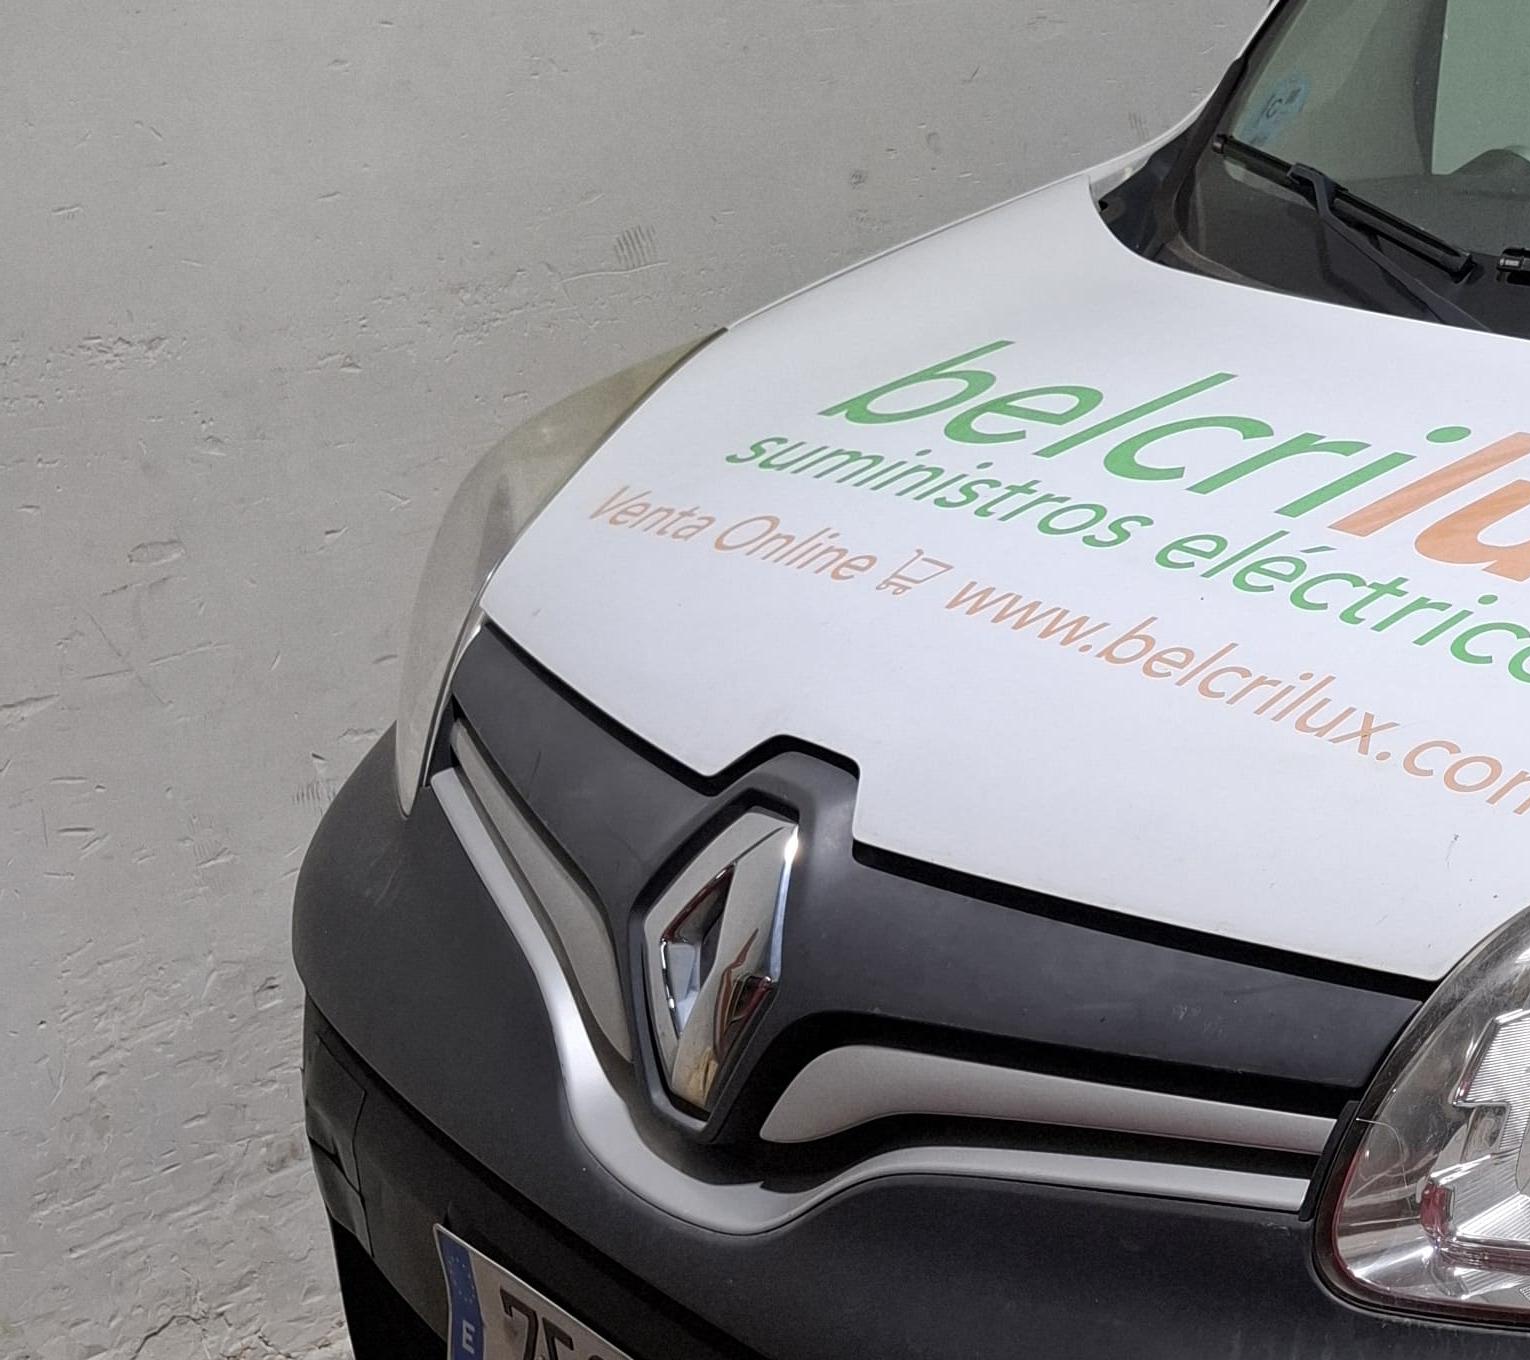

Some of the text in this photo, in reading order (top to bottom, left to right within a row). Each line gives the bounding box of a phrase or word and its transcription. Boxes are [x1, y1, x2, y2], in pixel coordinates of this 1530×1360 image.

[589, 485, 716, 541] Venta
[714, 514, 878, 581] Online
[725, 435, 1155, 548] suministros
[461, 1319, 476, 1354] E
